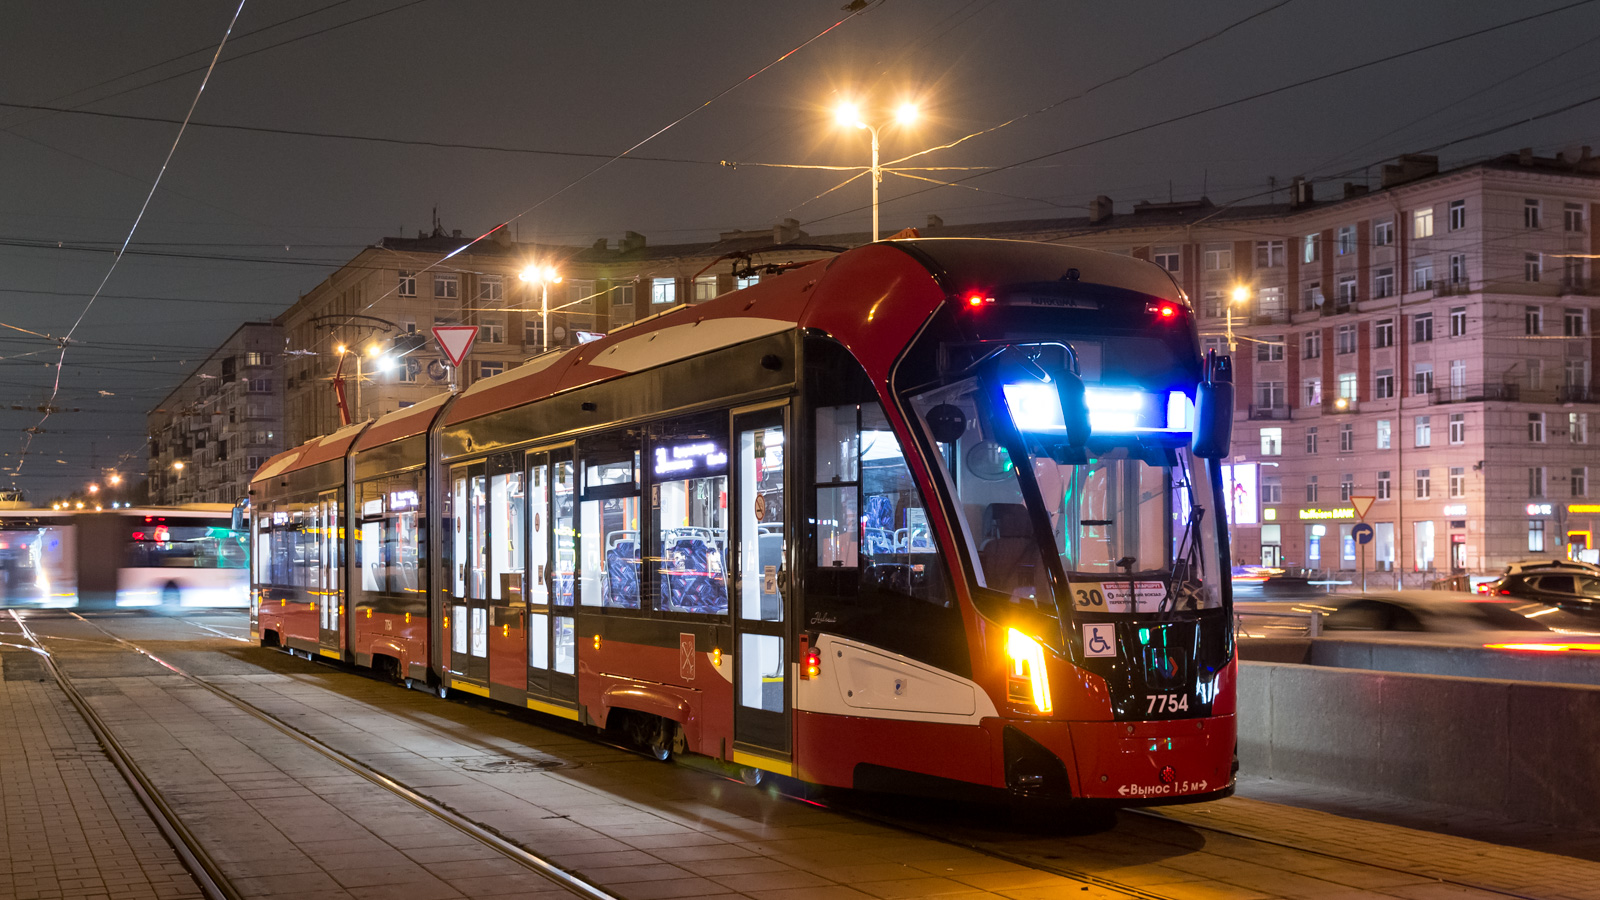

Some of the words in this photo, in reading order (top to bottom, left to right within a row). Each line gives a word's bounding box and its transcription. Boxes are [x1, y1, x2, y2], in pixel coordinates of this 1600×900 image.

[1332, 508, 1355, 519] BANK
[1076, 589, 1103, 606] 30
[1146, 694, 1188, 713] 7754
[1130, 783, 1170, 795] Вынос
[1174, 781, 1188, 794] 1,5
[1190, 782, 1199, 791] м
